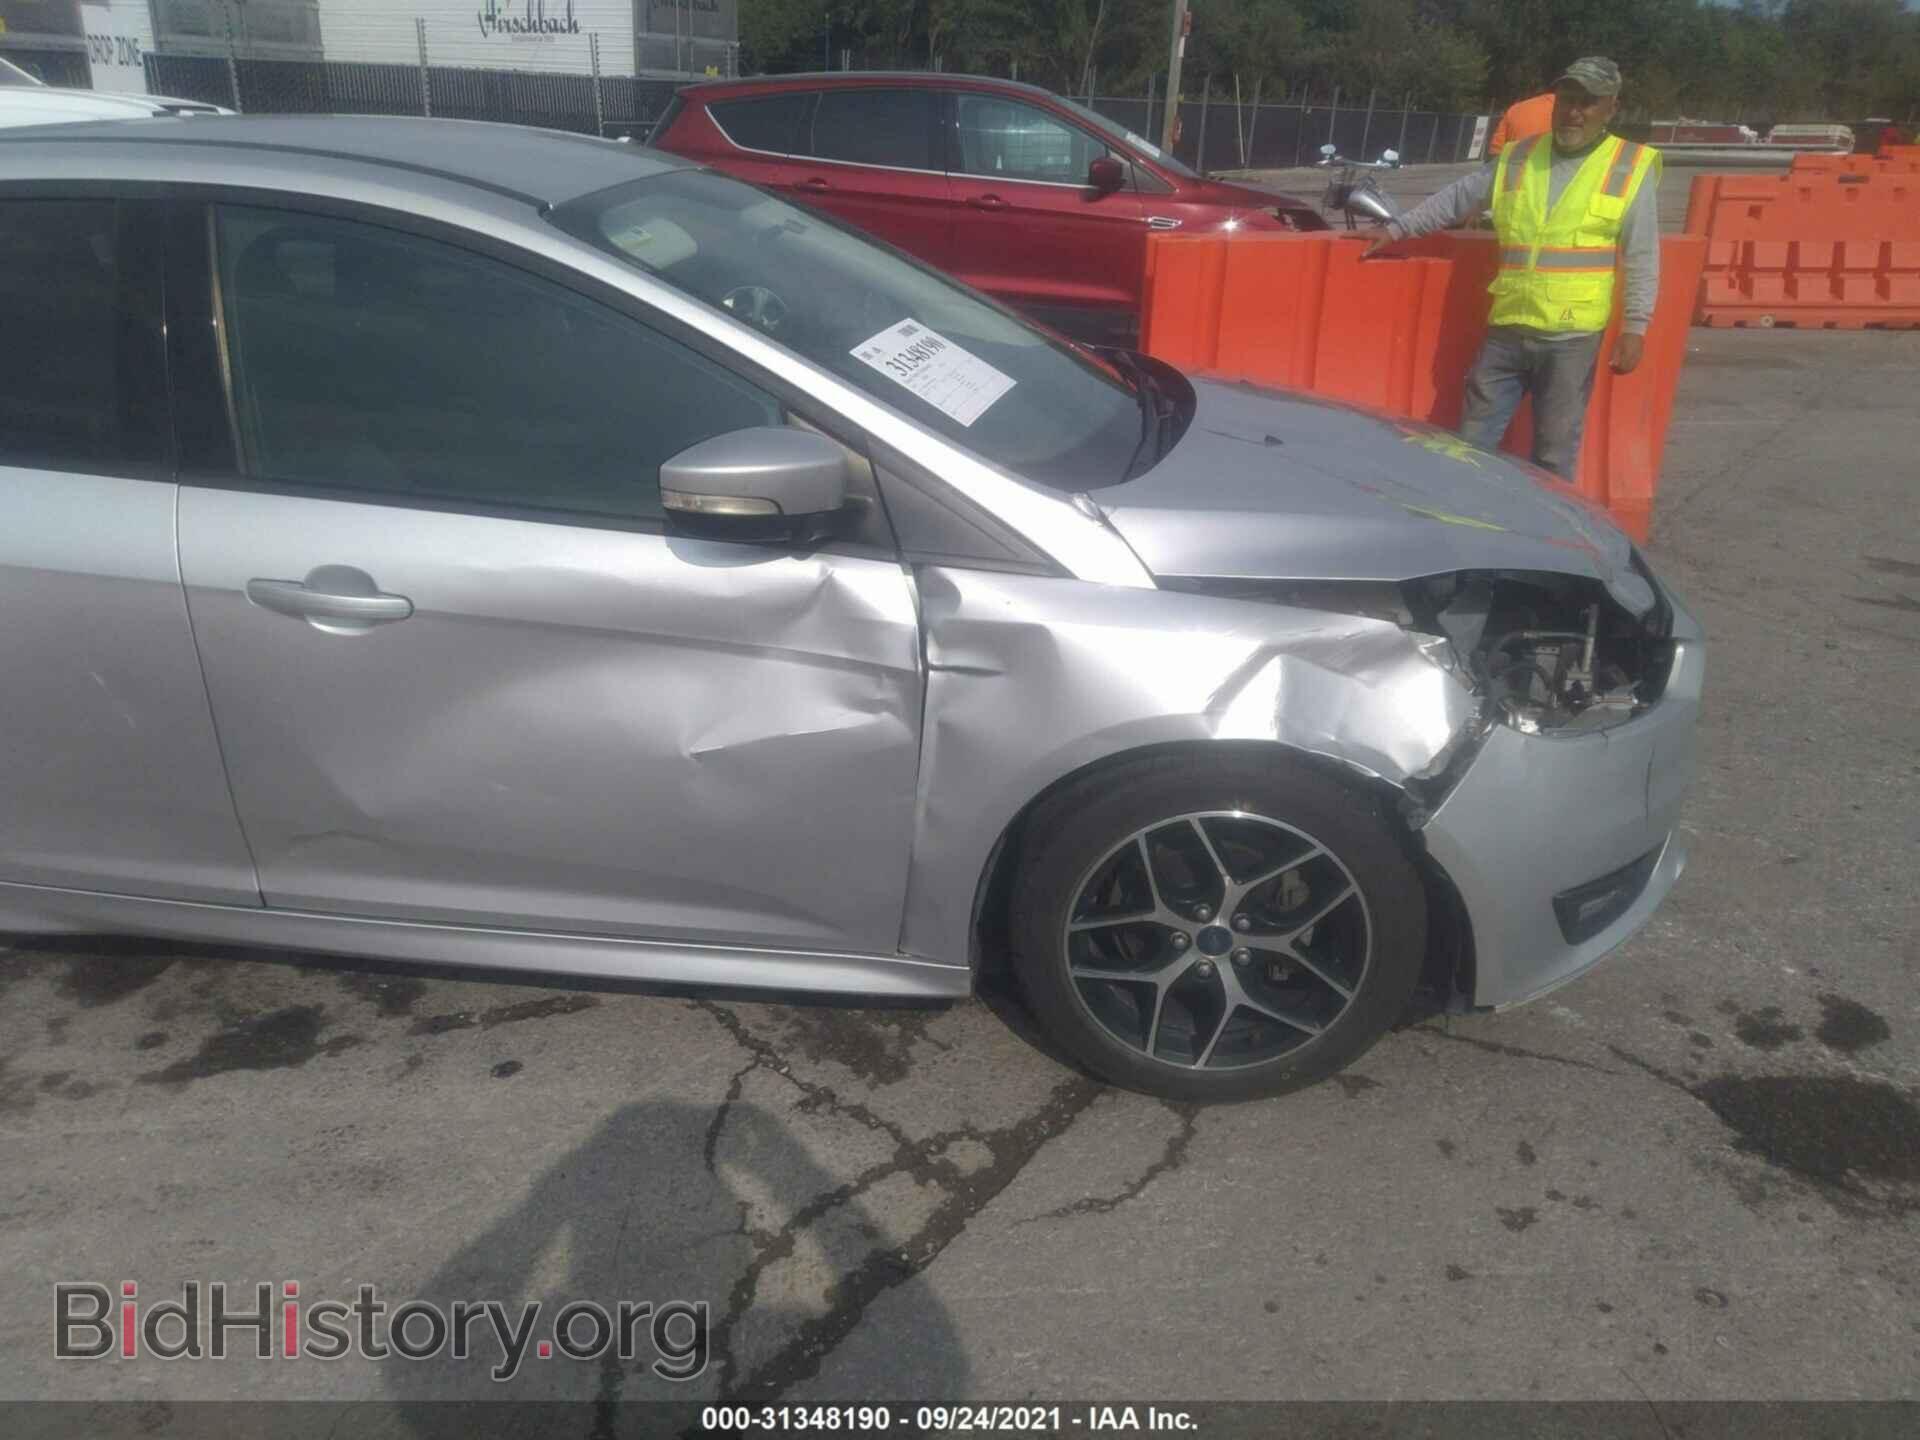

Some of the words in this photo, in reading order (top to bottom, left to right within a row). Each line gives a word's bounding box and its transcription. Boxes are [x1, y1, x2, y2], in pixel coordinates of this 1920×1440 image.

[478, 0, 580, 38] Hirschbach
[87, 33, 113, 66] DROP
[114, 36, 143, 67] ZONE
[886, 335, 947, 377] 31348190
